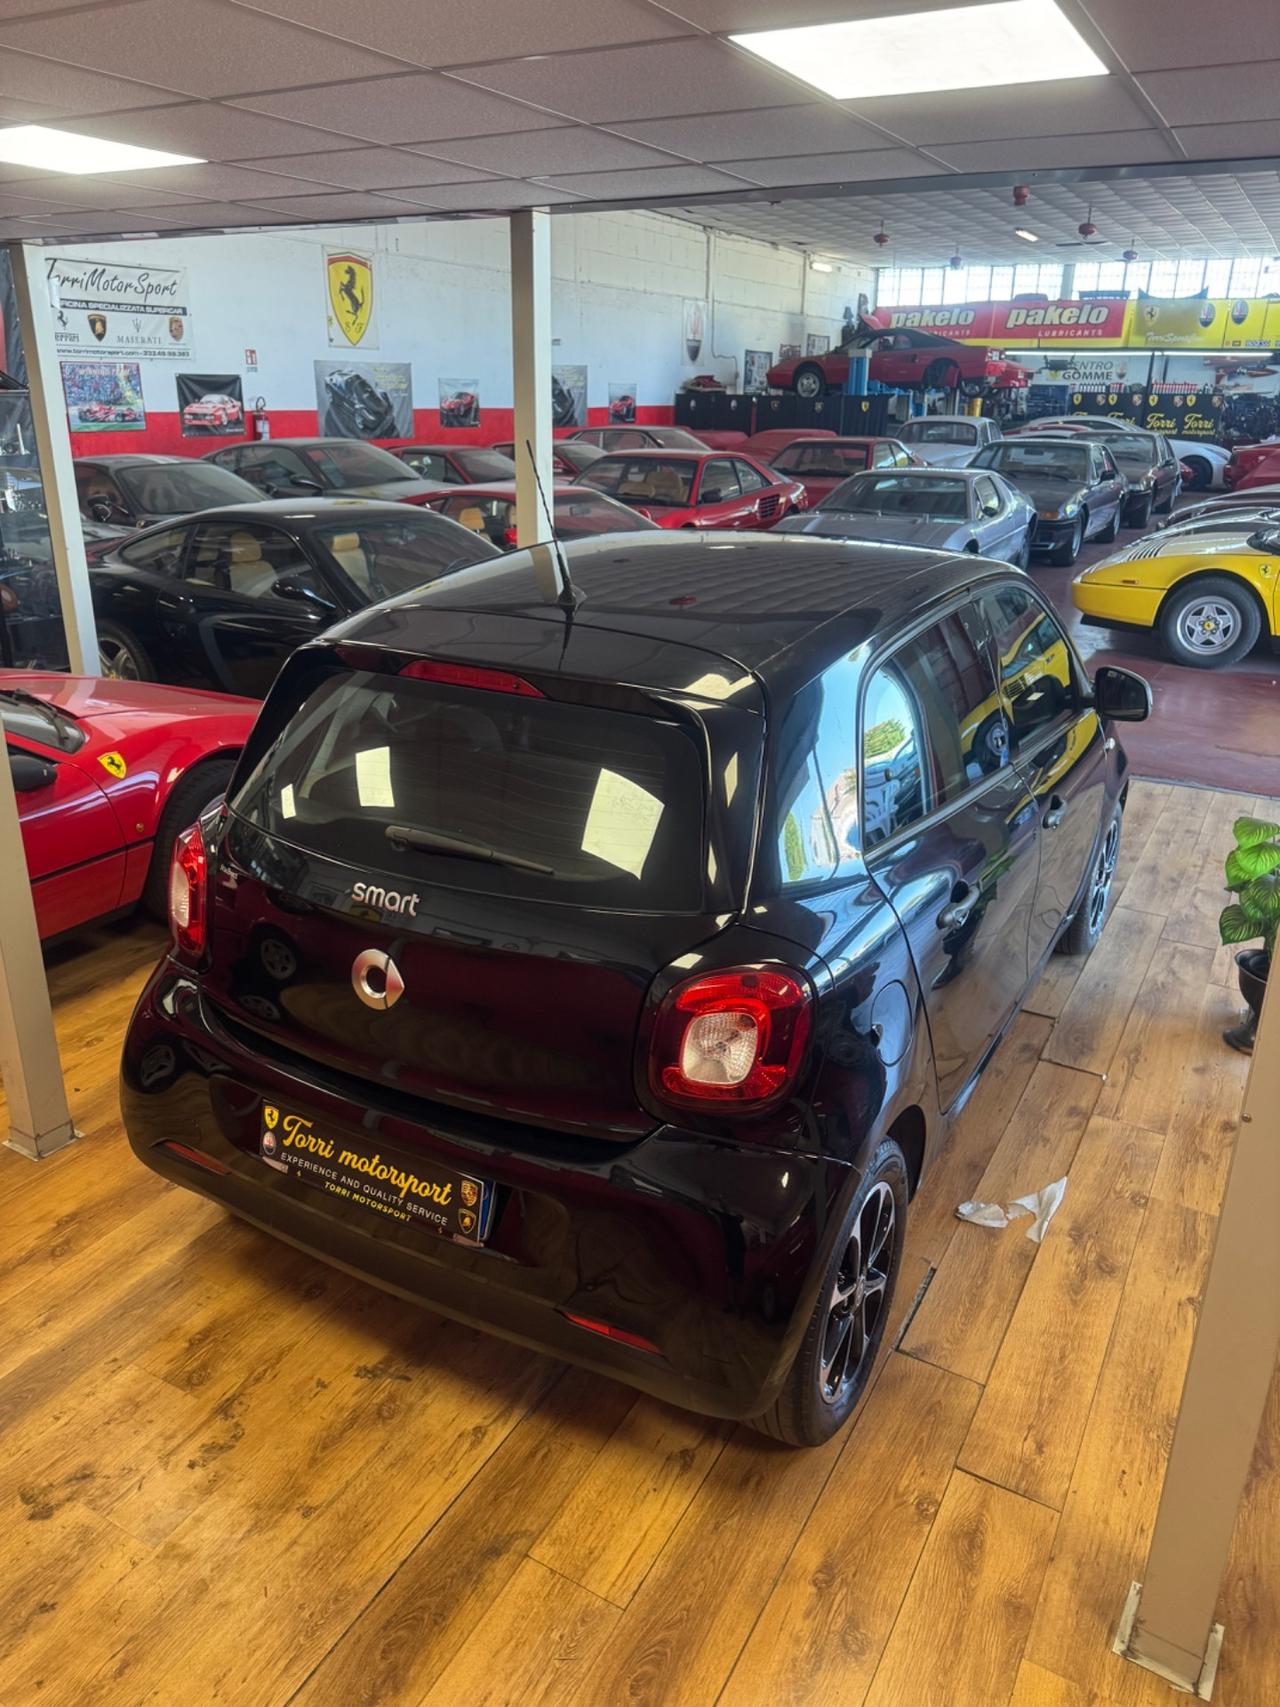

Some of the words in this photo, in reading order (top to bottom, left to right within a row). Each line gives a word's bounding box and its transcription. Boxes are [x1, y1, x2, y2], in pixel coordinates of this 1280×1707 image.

[889, 307, 976, 329] pakelo
[1004, 304, 1109, 329] pakelo
[116, 335, 162, 345] MASERATI
[933, 329, 971, 337] RICANTS
[1038, 329, 1103, 337] LUBRICANTS
[1062, 371, 1113, 380] GOMME
[1146, 412, 1177, 429] Torri
[1183, 412, 1214, 429] Torri
[352, 882, 420, 917] smart
[282, 1115, 335, 1159] Torri
[338, 1148, 452, 1206] motorsport
[281, 1152, 338, 1180] EXPERIENCE
[340, 1175, 360, 1189] AND
[362, 1183, 403, 1207] QUALITY
[406, 1202, 449, 1226] SERVICE
[324, 1180, 350, 1199] TORRI
[352, 1193, 412, 1222] MOTORSPORT
